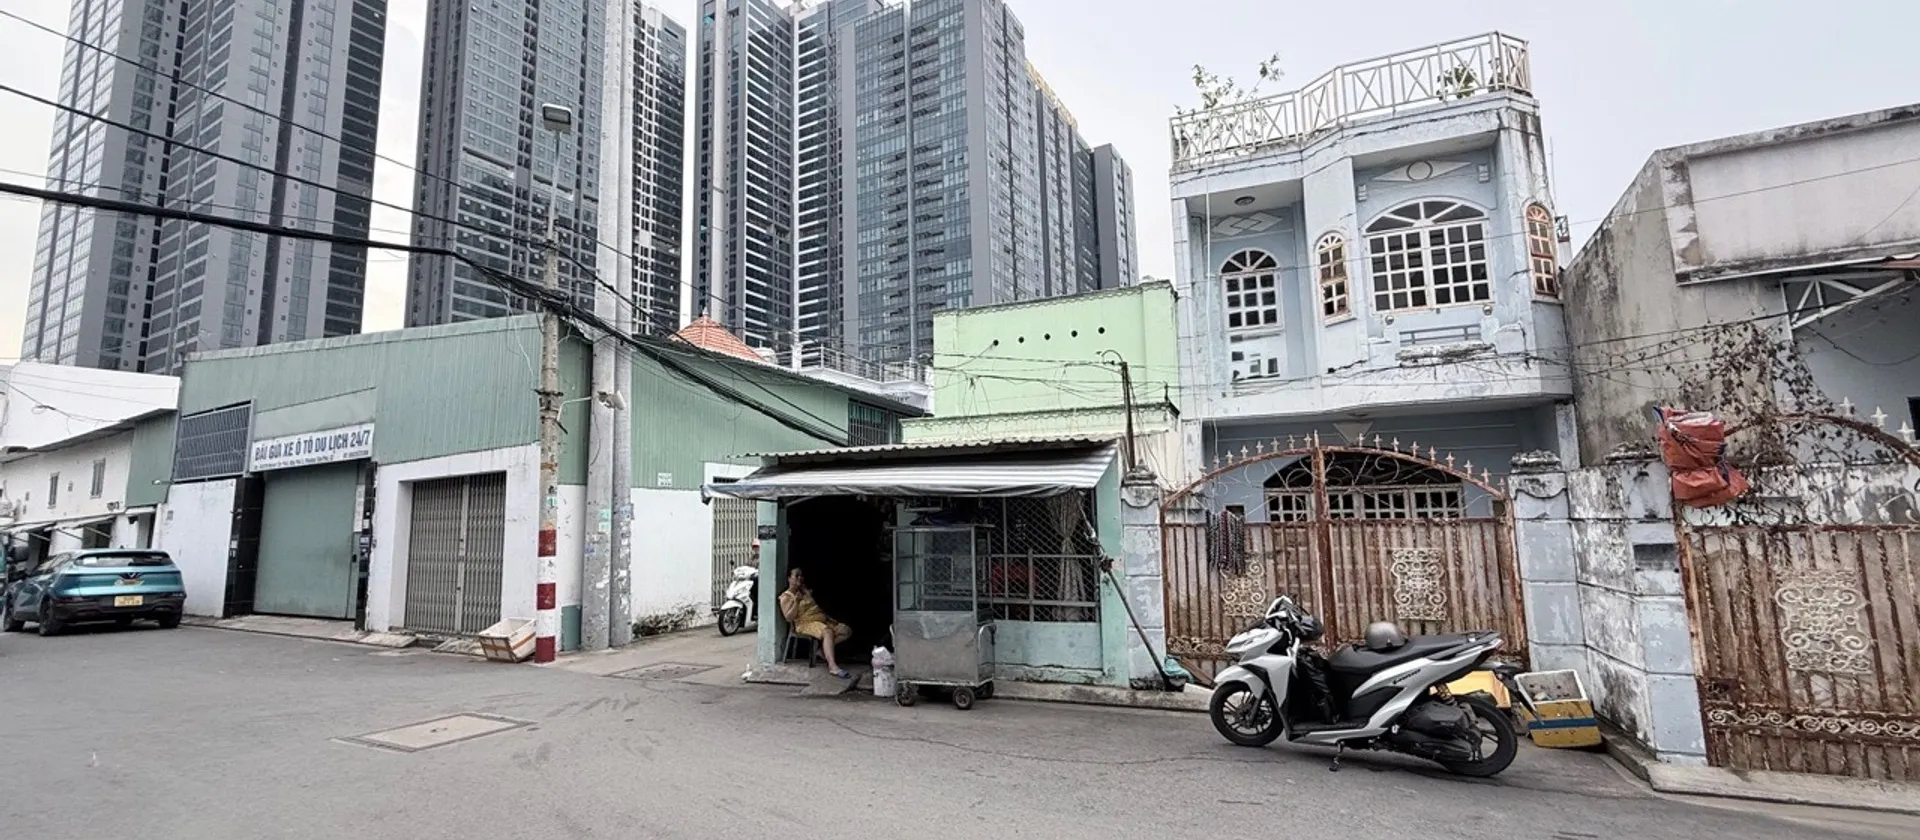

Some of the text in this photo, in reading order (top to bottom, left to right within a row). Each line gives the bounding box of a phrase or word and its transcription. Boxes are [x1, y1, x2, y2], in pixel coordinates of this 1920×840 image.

[283, 441, 294, 456] XE
[315, 437, 327, 452] DU
[350, 430, 370, 446] 24/7
